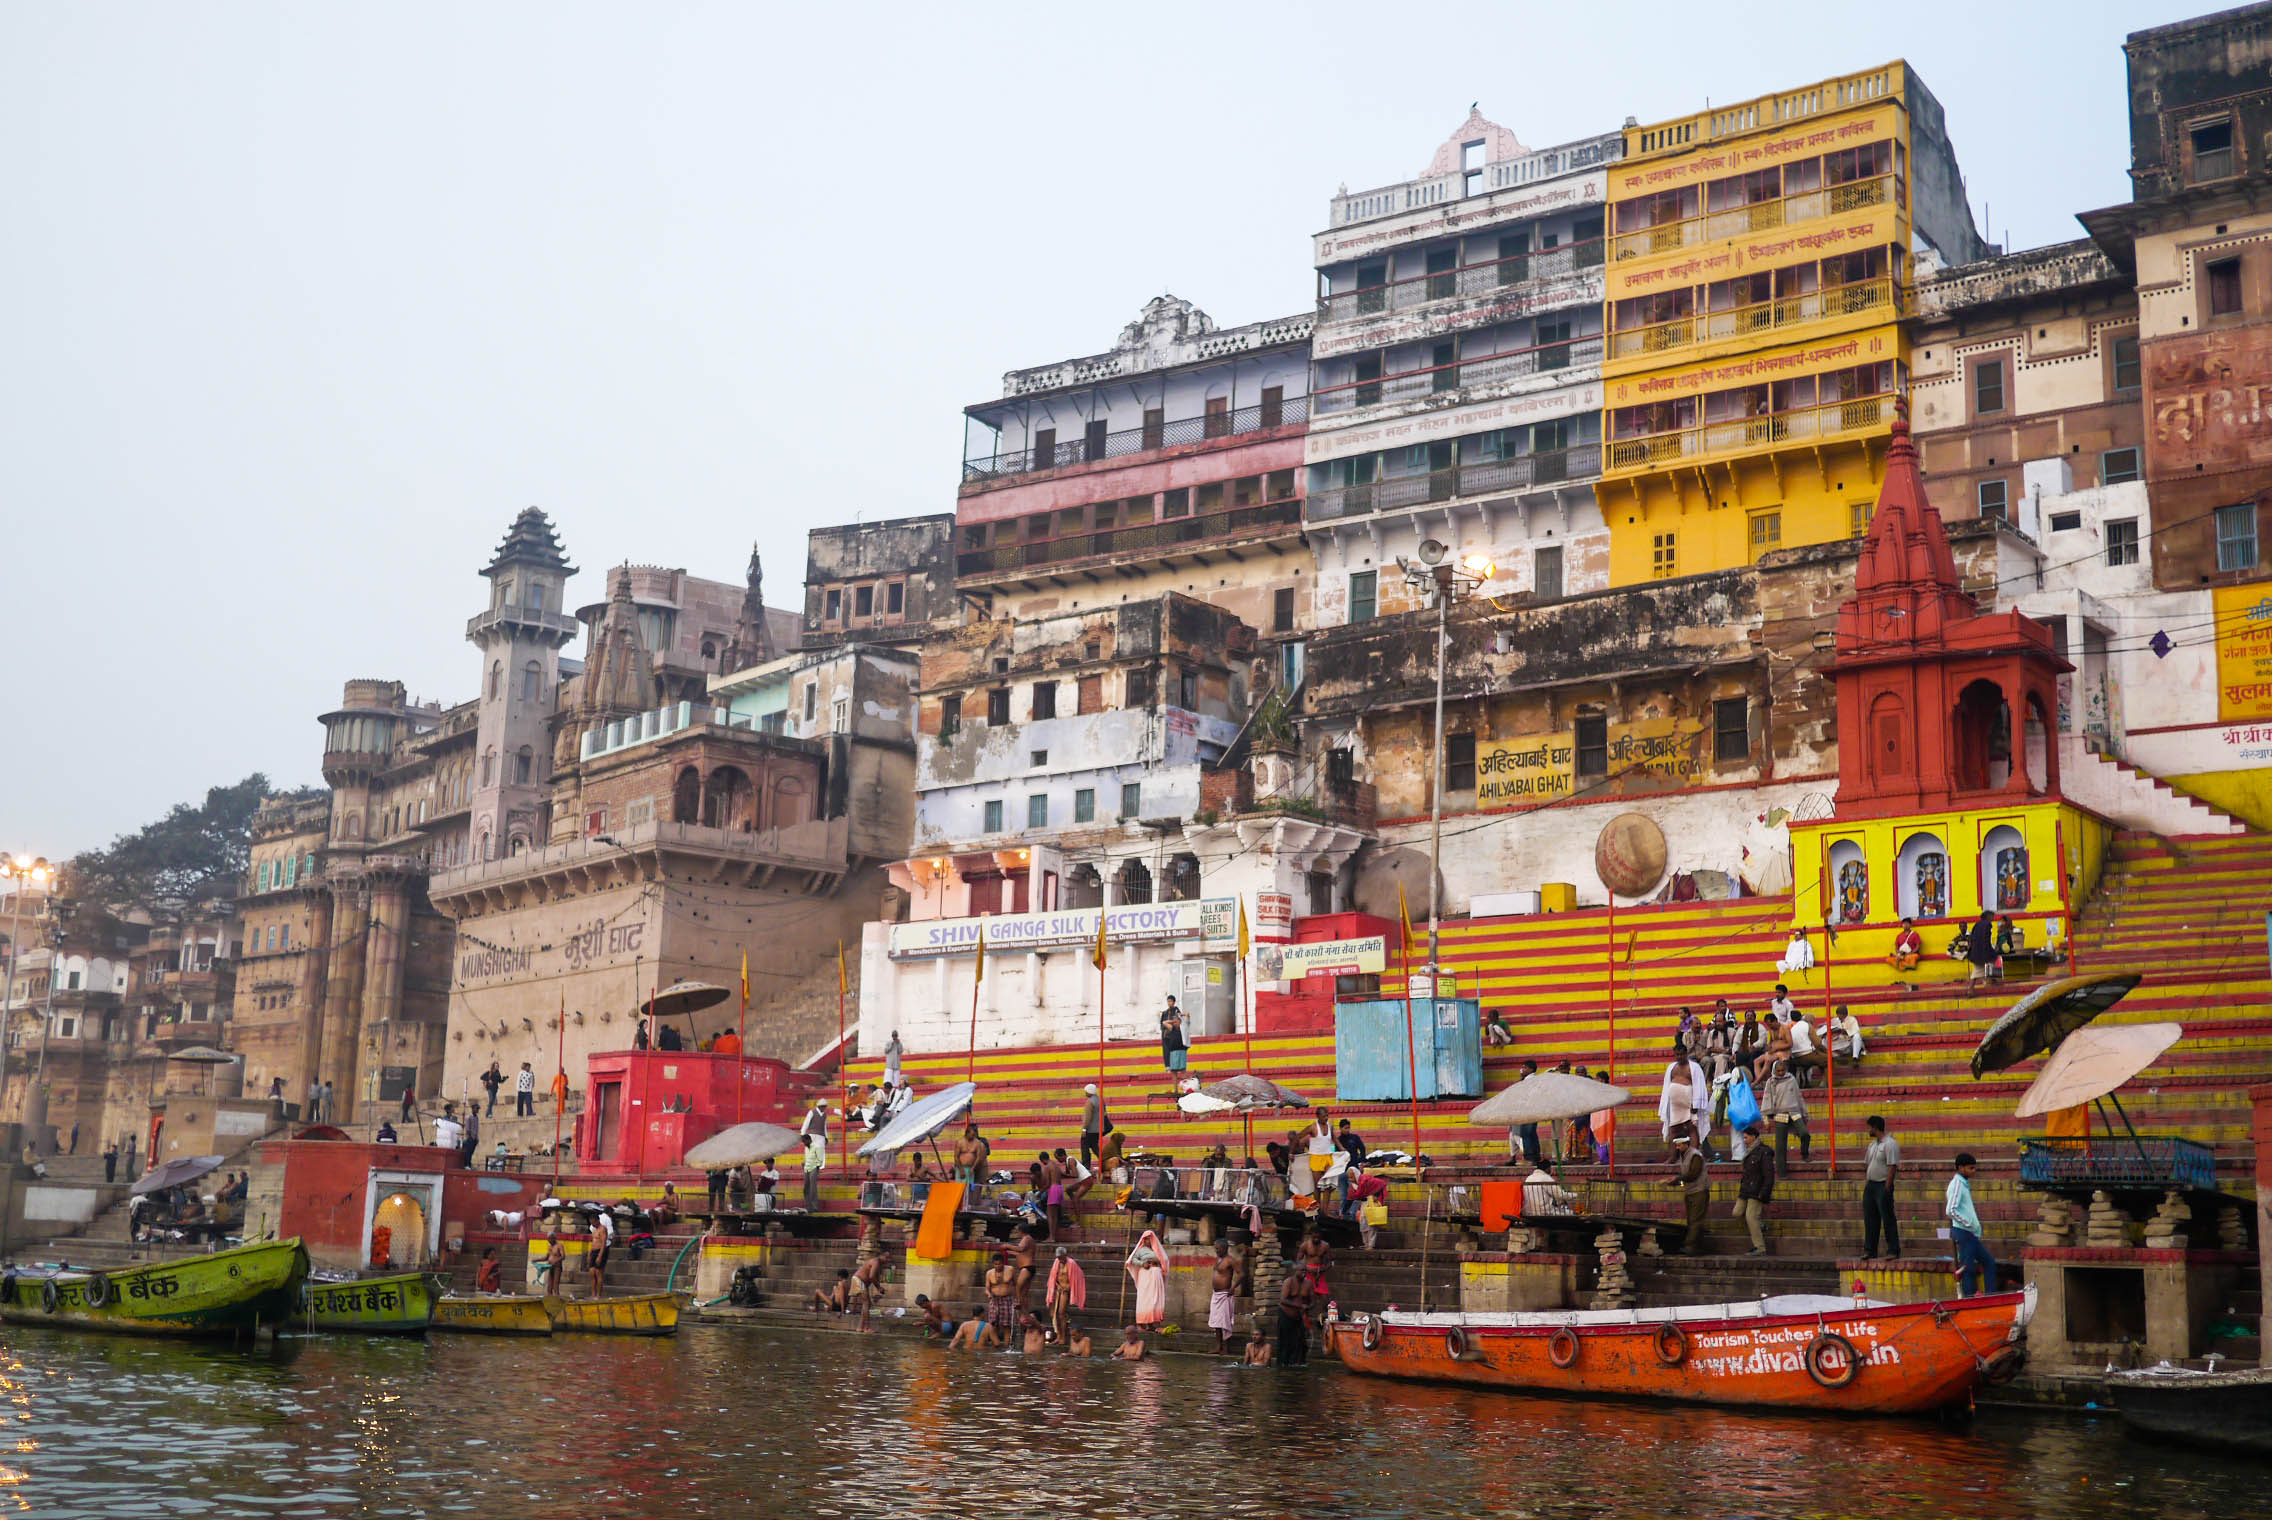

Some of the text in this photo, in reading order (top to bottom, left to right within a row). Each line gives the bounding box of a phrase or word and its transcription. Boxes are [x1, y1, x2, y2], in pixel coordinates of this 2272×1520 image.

[1624, 269, 1664, 288] उमाचरण
[1638, 376, 1675, 394] कविराज
[2223, 728, 2240, 745] श्री
[2243, 726, 2260, 743] श्री
[1478, 743, 1571, 775] अहिल्याबाई घाट
[1479, 778, 1534, 800] AHILYABAI
[1537, 774, 1571, 793] GHAT
[1202, 904, 1213, 914] ALL
[1215, 903, 1232, 912] KINDS
[1257, 904, 1273, 913] SILK
[929, 909, 1179, 945] SHIV GANGA SILK FACTORY
[1119, 931, 1137, 941] Dress
[1173, 927, 1188, 937] Suits
[1207, 924, 1228, 934] SUITS
[608, 922, 646, 954] घाट
[1305, 945, 1323, 957] काशी
[1325, 944, 1340, 956] गंगा
[1358, 939, 1382, 953] समिति
[129, 1274, 181, 1302] बैंक
[363, 1286, 400, 1312] बैंक
[1695, 1332, 1749, 1348] Tourism
[1751, 1327, 1814, 1345] Touches
[1845, 1321, 1878, 1338] Life
